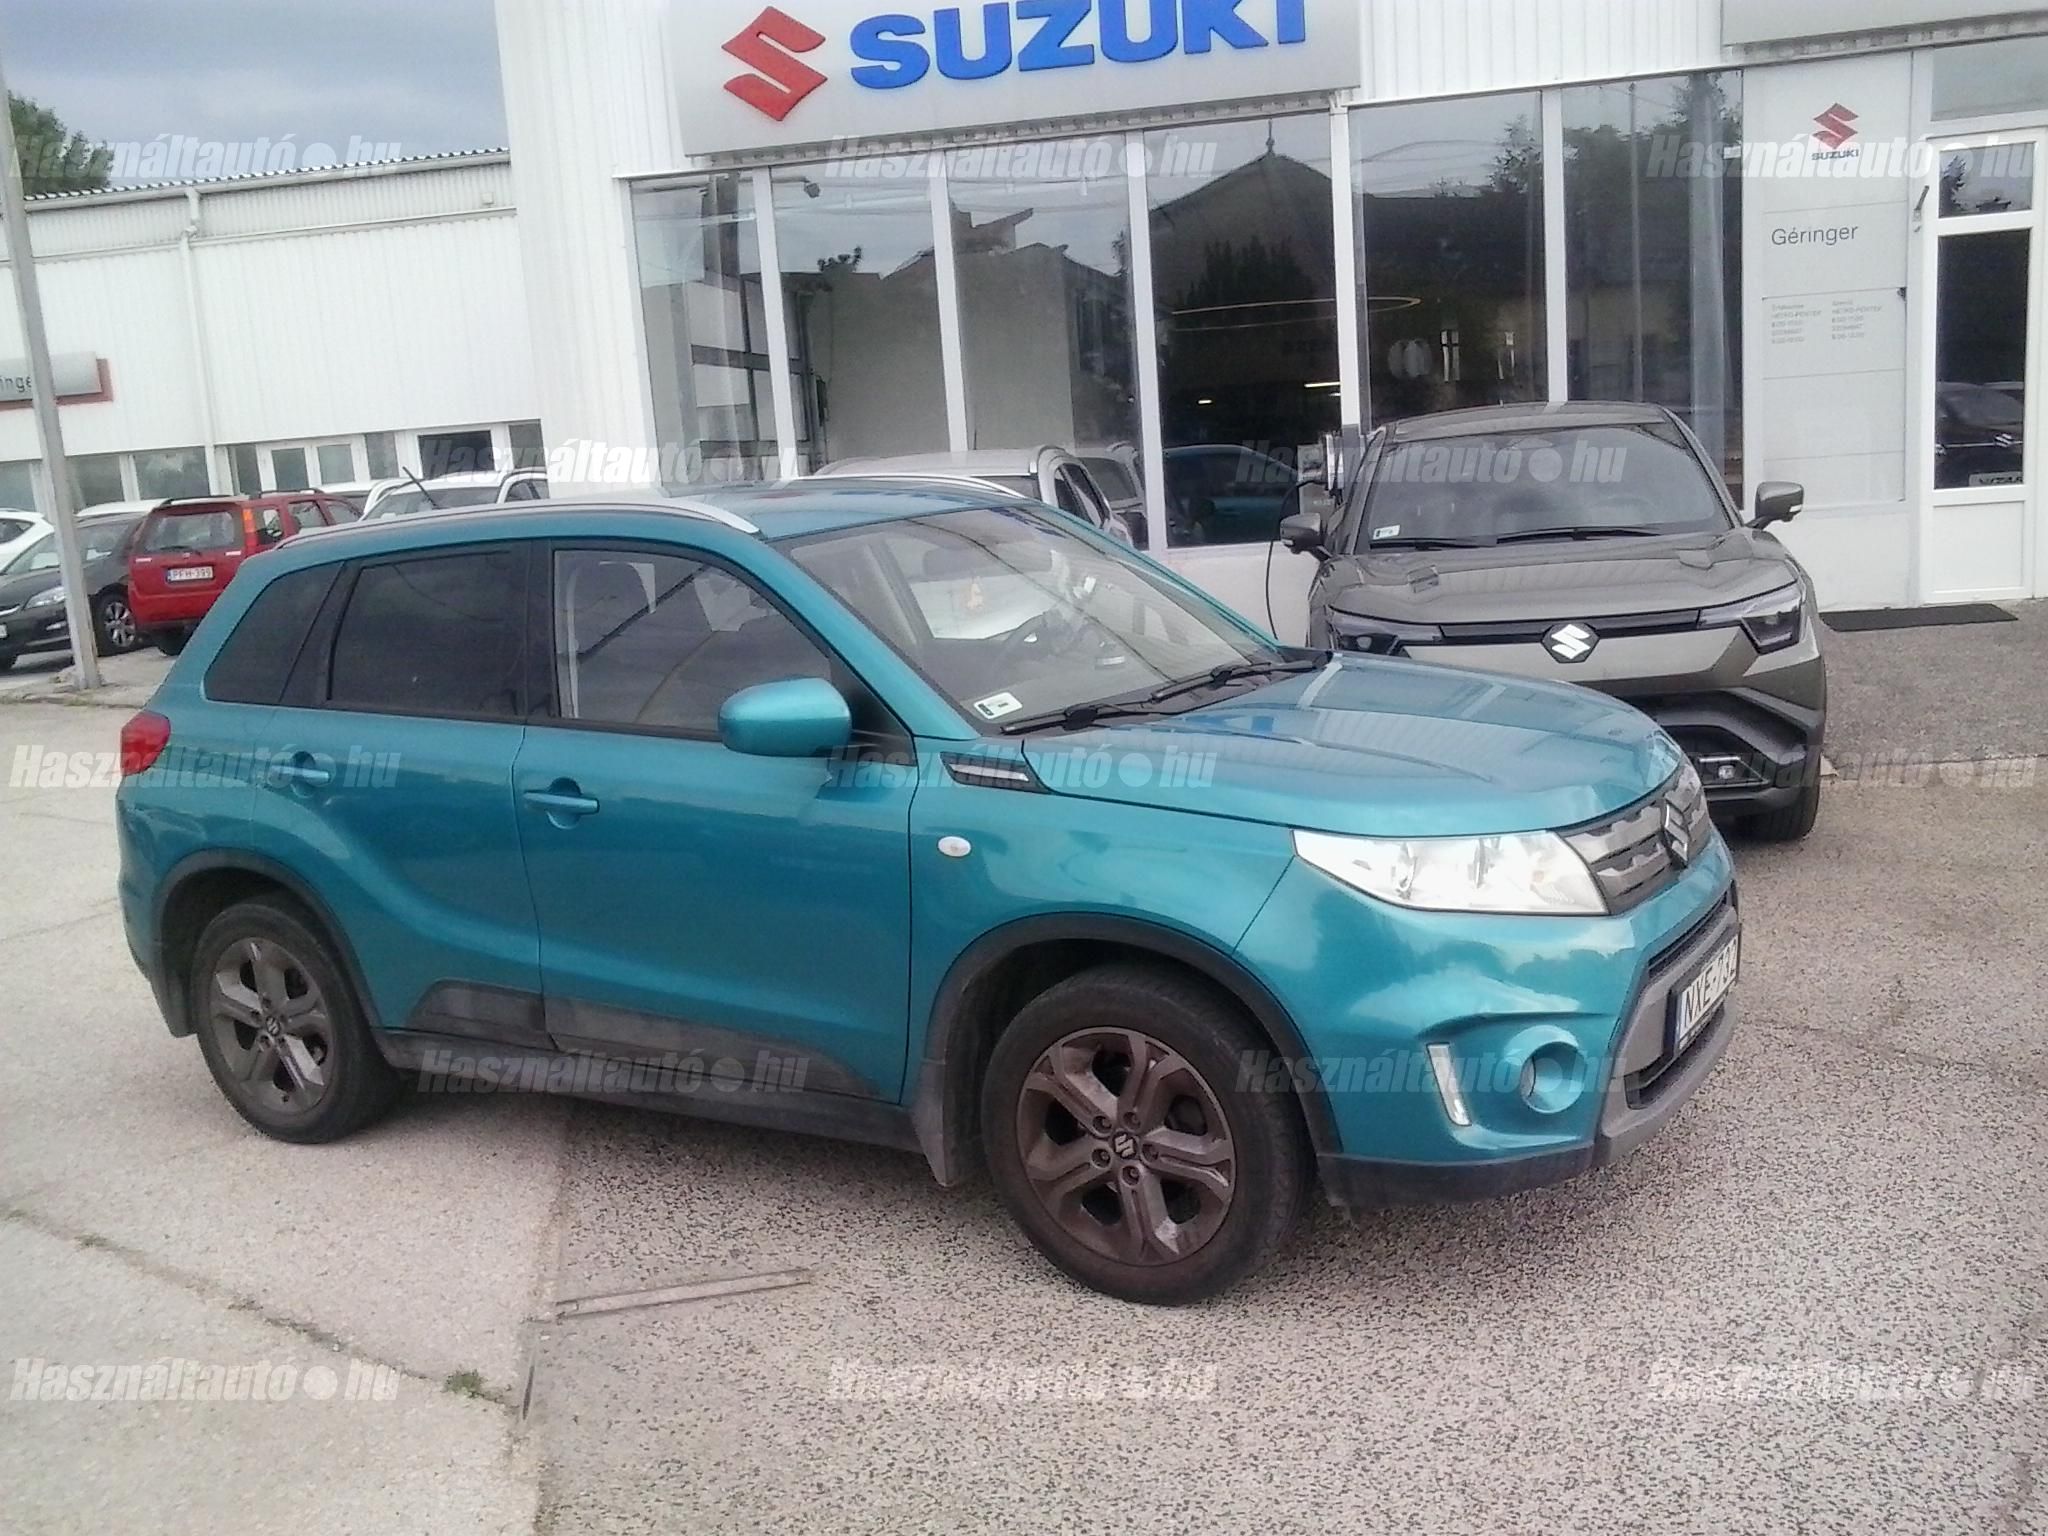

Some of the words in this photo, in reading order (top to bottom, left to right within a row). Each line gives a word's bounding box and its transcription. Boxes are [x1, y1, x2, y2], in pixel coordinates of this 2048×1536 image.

[850, 0, 1306, 89] SUZUKI
[1811, 149, 1859, 161] SUZUKI
[1771, 226, 1859, 246] Géringer
